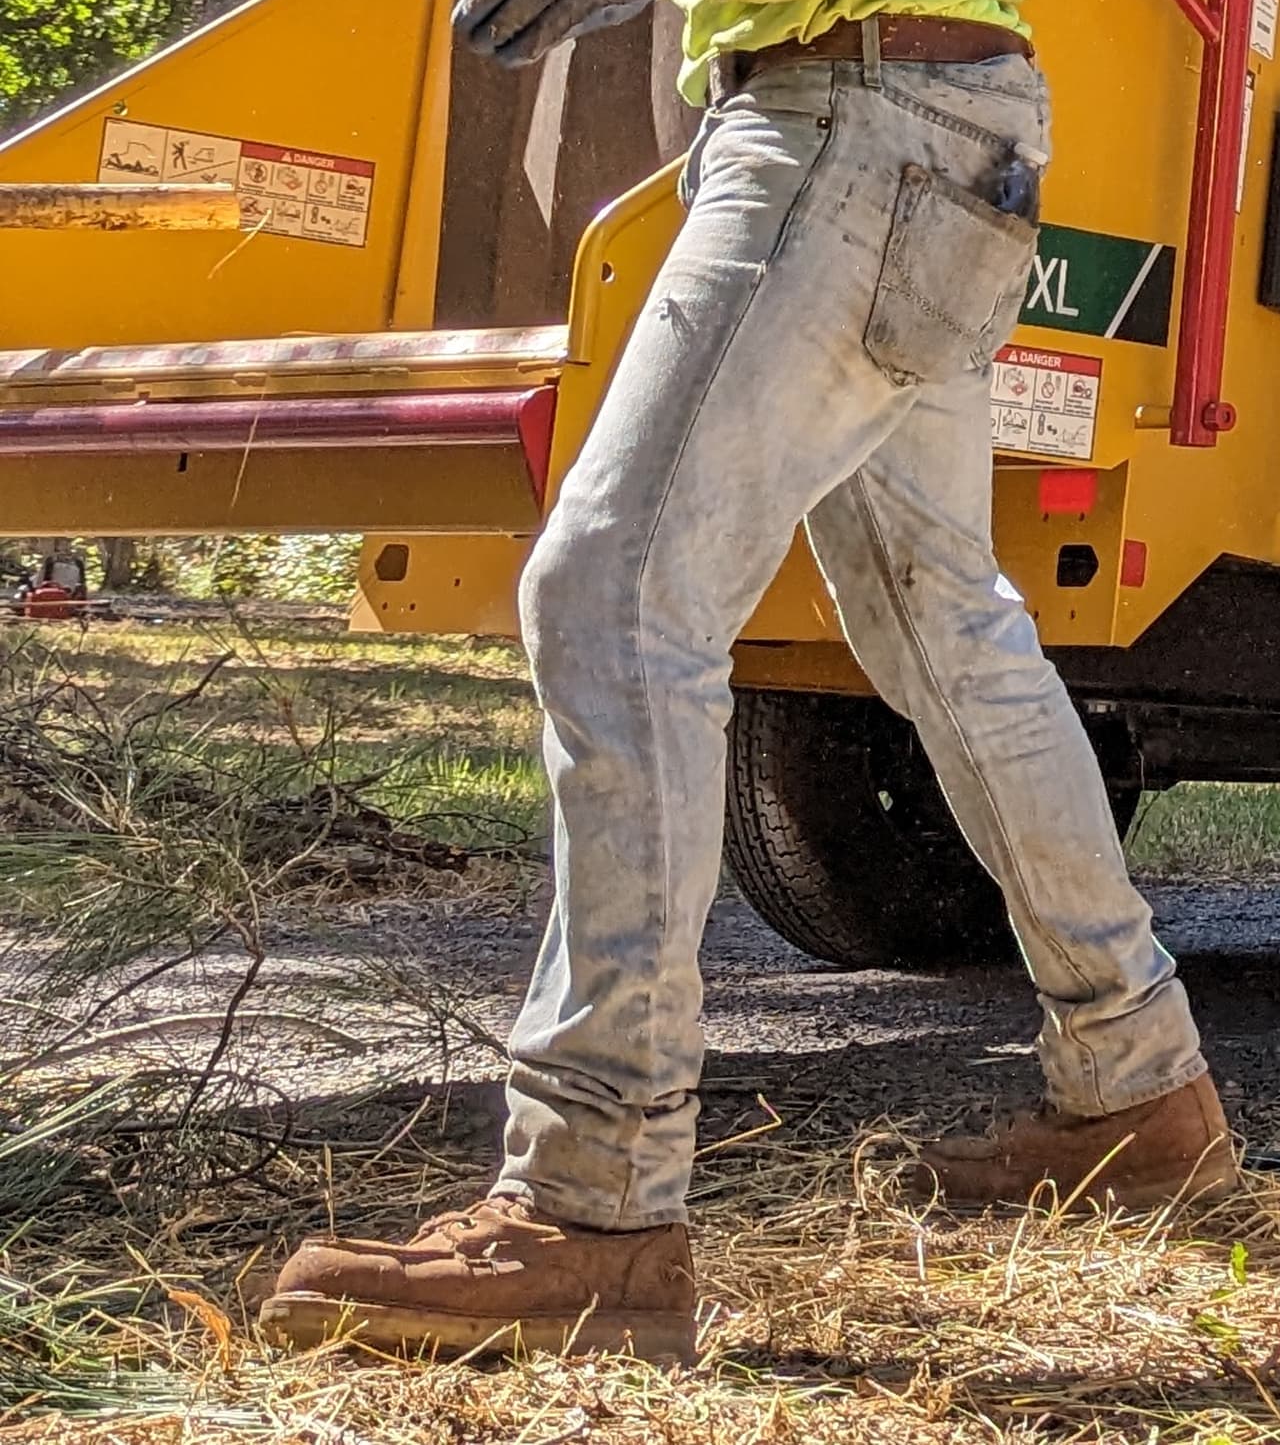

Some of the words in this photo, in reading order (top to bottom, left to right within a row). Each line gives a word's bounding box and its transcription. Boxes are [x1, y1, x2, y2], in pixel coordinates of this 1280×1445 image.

[293, 153, 335, 169] DANGER
[1026, 254, 1080, 317] XL
[1020, 353, 1062, 368] DANGER
